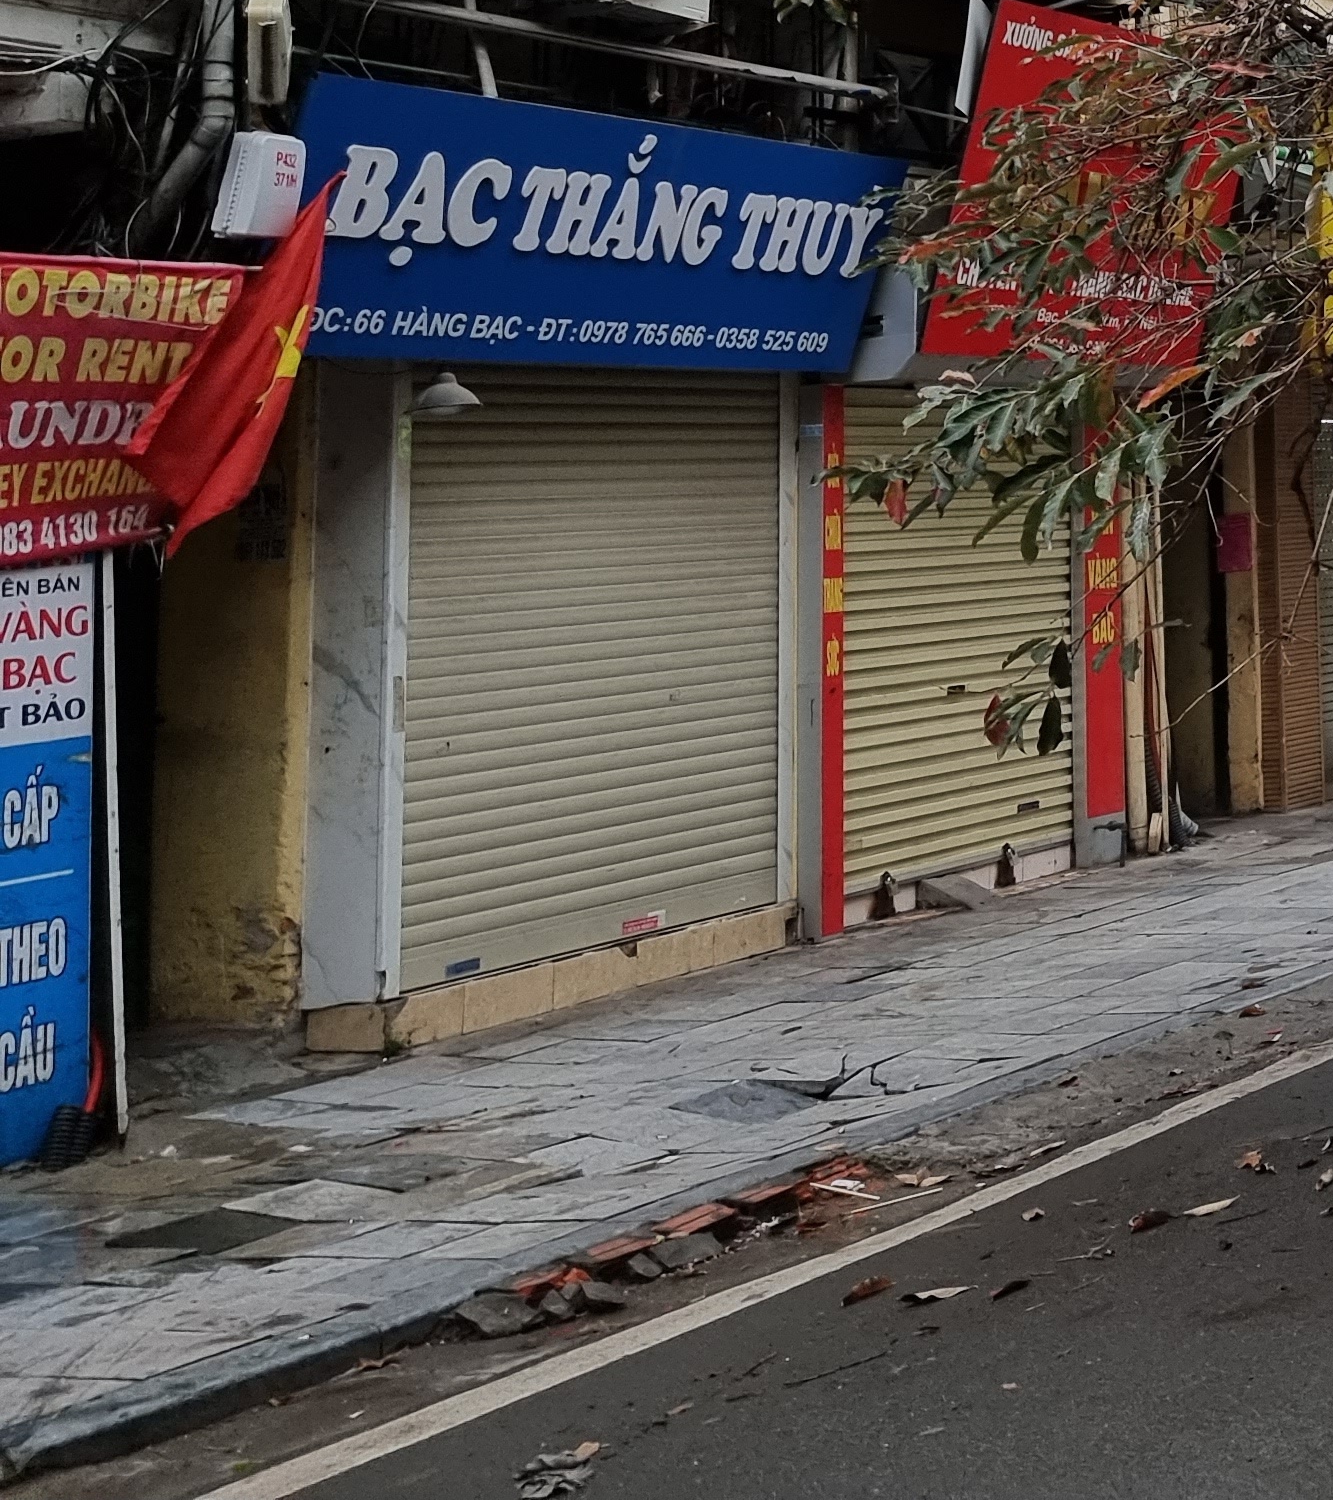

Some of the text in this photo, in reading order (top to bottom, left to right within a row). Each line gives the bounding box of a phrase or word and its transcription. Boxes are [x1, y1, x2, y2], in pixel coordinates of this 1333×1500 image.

[325, 143, 513, 268] BẠC
[512, 133, 730, 266] THẮNG
[4, 266, 232, 325] OTORBIKE
[391, 305, 468, 338] HÀNG
[469, 314, 523, 345] BẠC
[632, 322, 670, 346] 765
[762, 329, 796, 352] 525
[796, 332, 829, 353] 609
[0, 335, 194, 384] OR RENT
[31, 459, 154, 504] EXCHAN
[0, 519, 33, 556] 83
[40, 510, 98, 550] 4130
[2, 572, 80, 598] ÊN BÁN
[2, 652, 77, 695] BẠC
[21, 693, 86, 727] BẢO
[3, 765, 59, 849] CẤP
